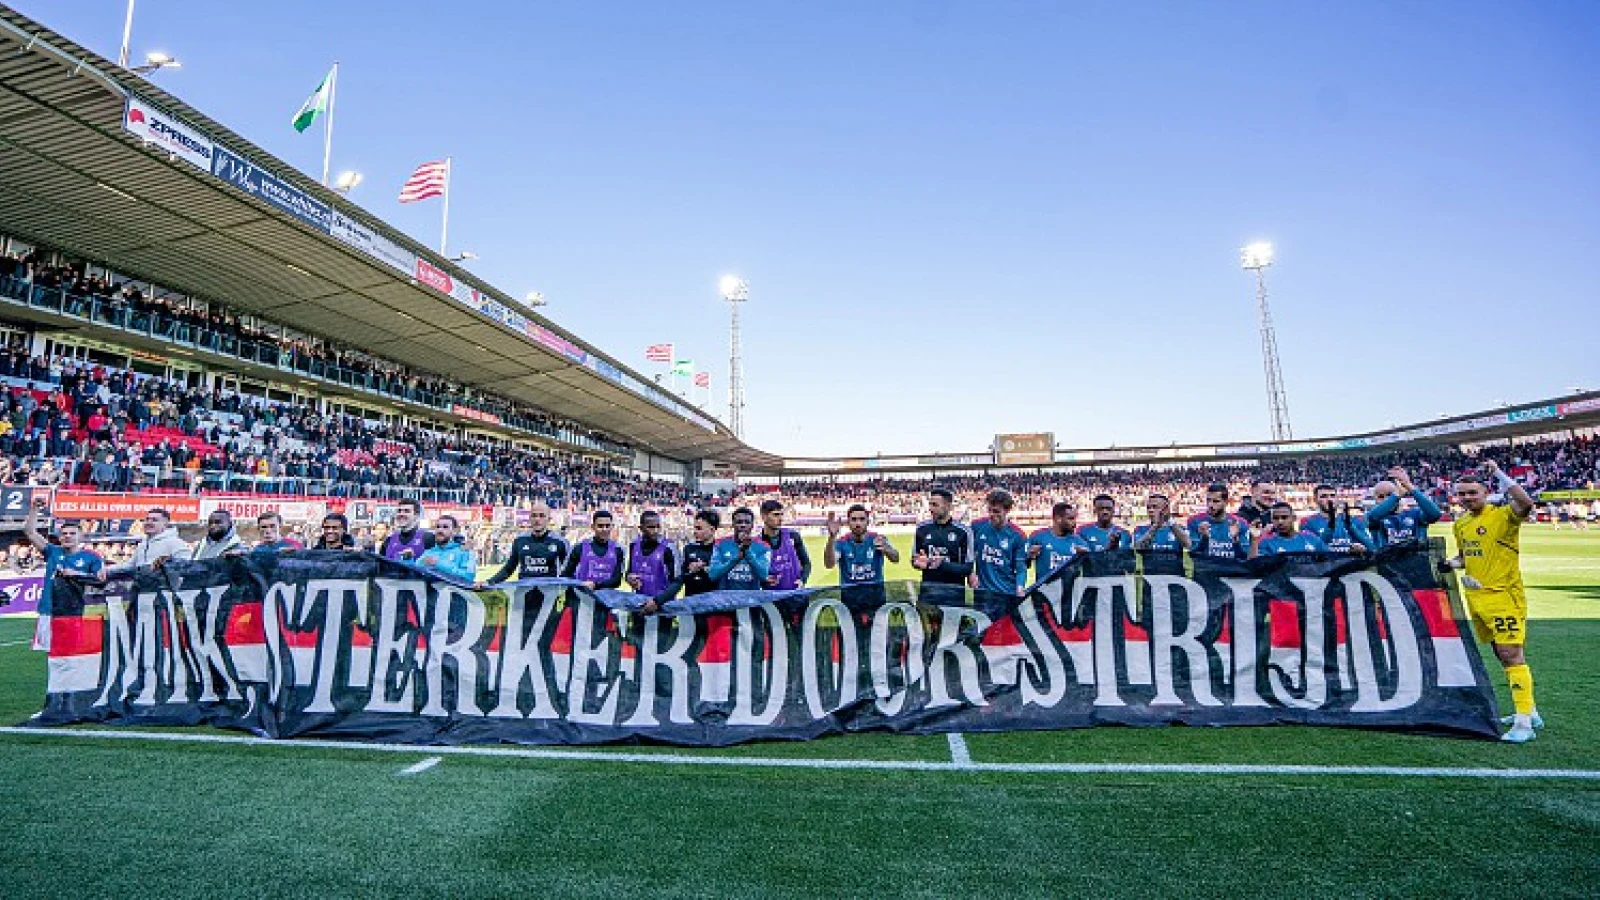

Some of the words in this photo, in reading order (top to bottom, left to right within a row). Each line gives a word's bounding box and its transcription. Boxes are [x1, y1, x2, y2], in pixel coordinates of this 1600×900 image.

[149, 116, 212, 159] ZPRESS
[6, 491, 23, 510] 2
[1494, 615, 1520, 632] 22
[262, 576, 697, 727] STERKER
[726, 597, 993, 726] DOOR
[1017, 571, 1425, 713] STRIJD
